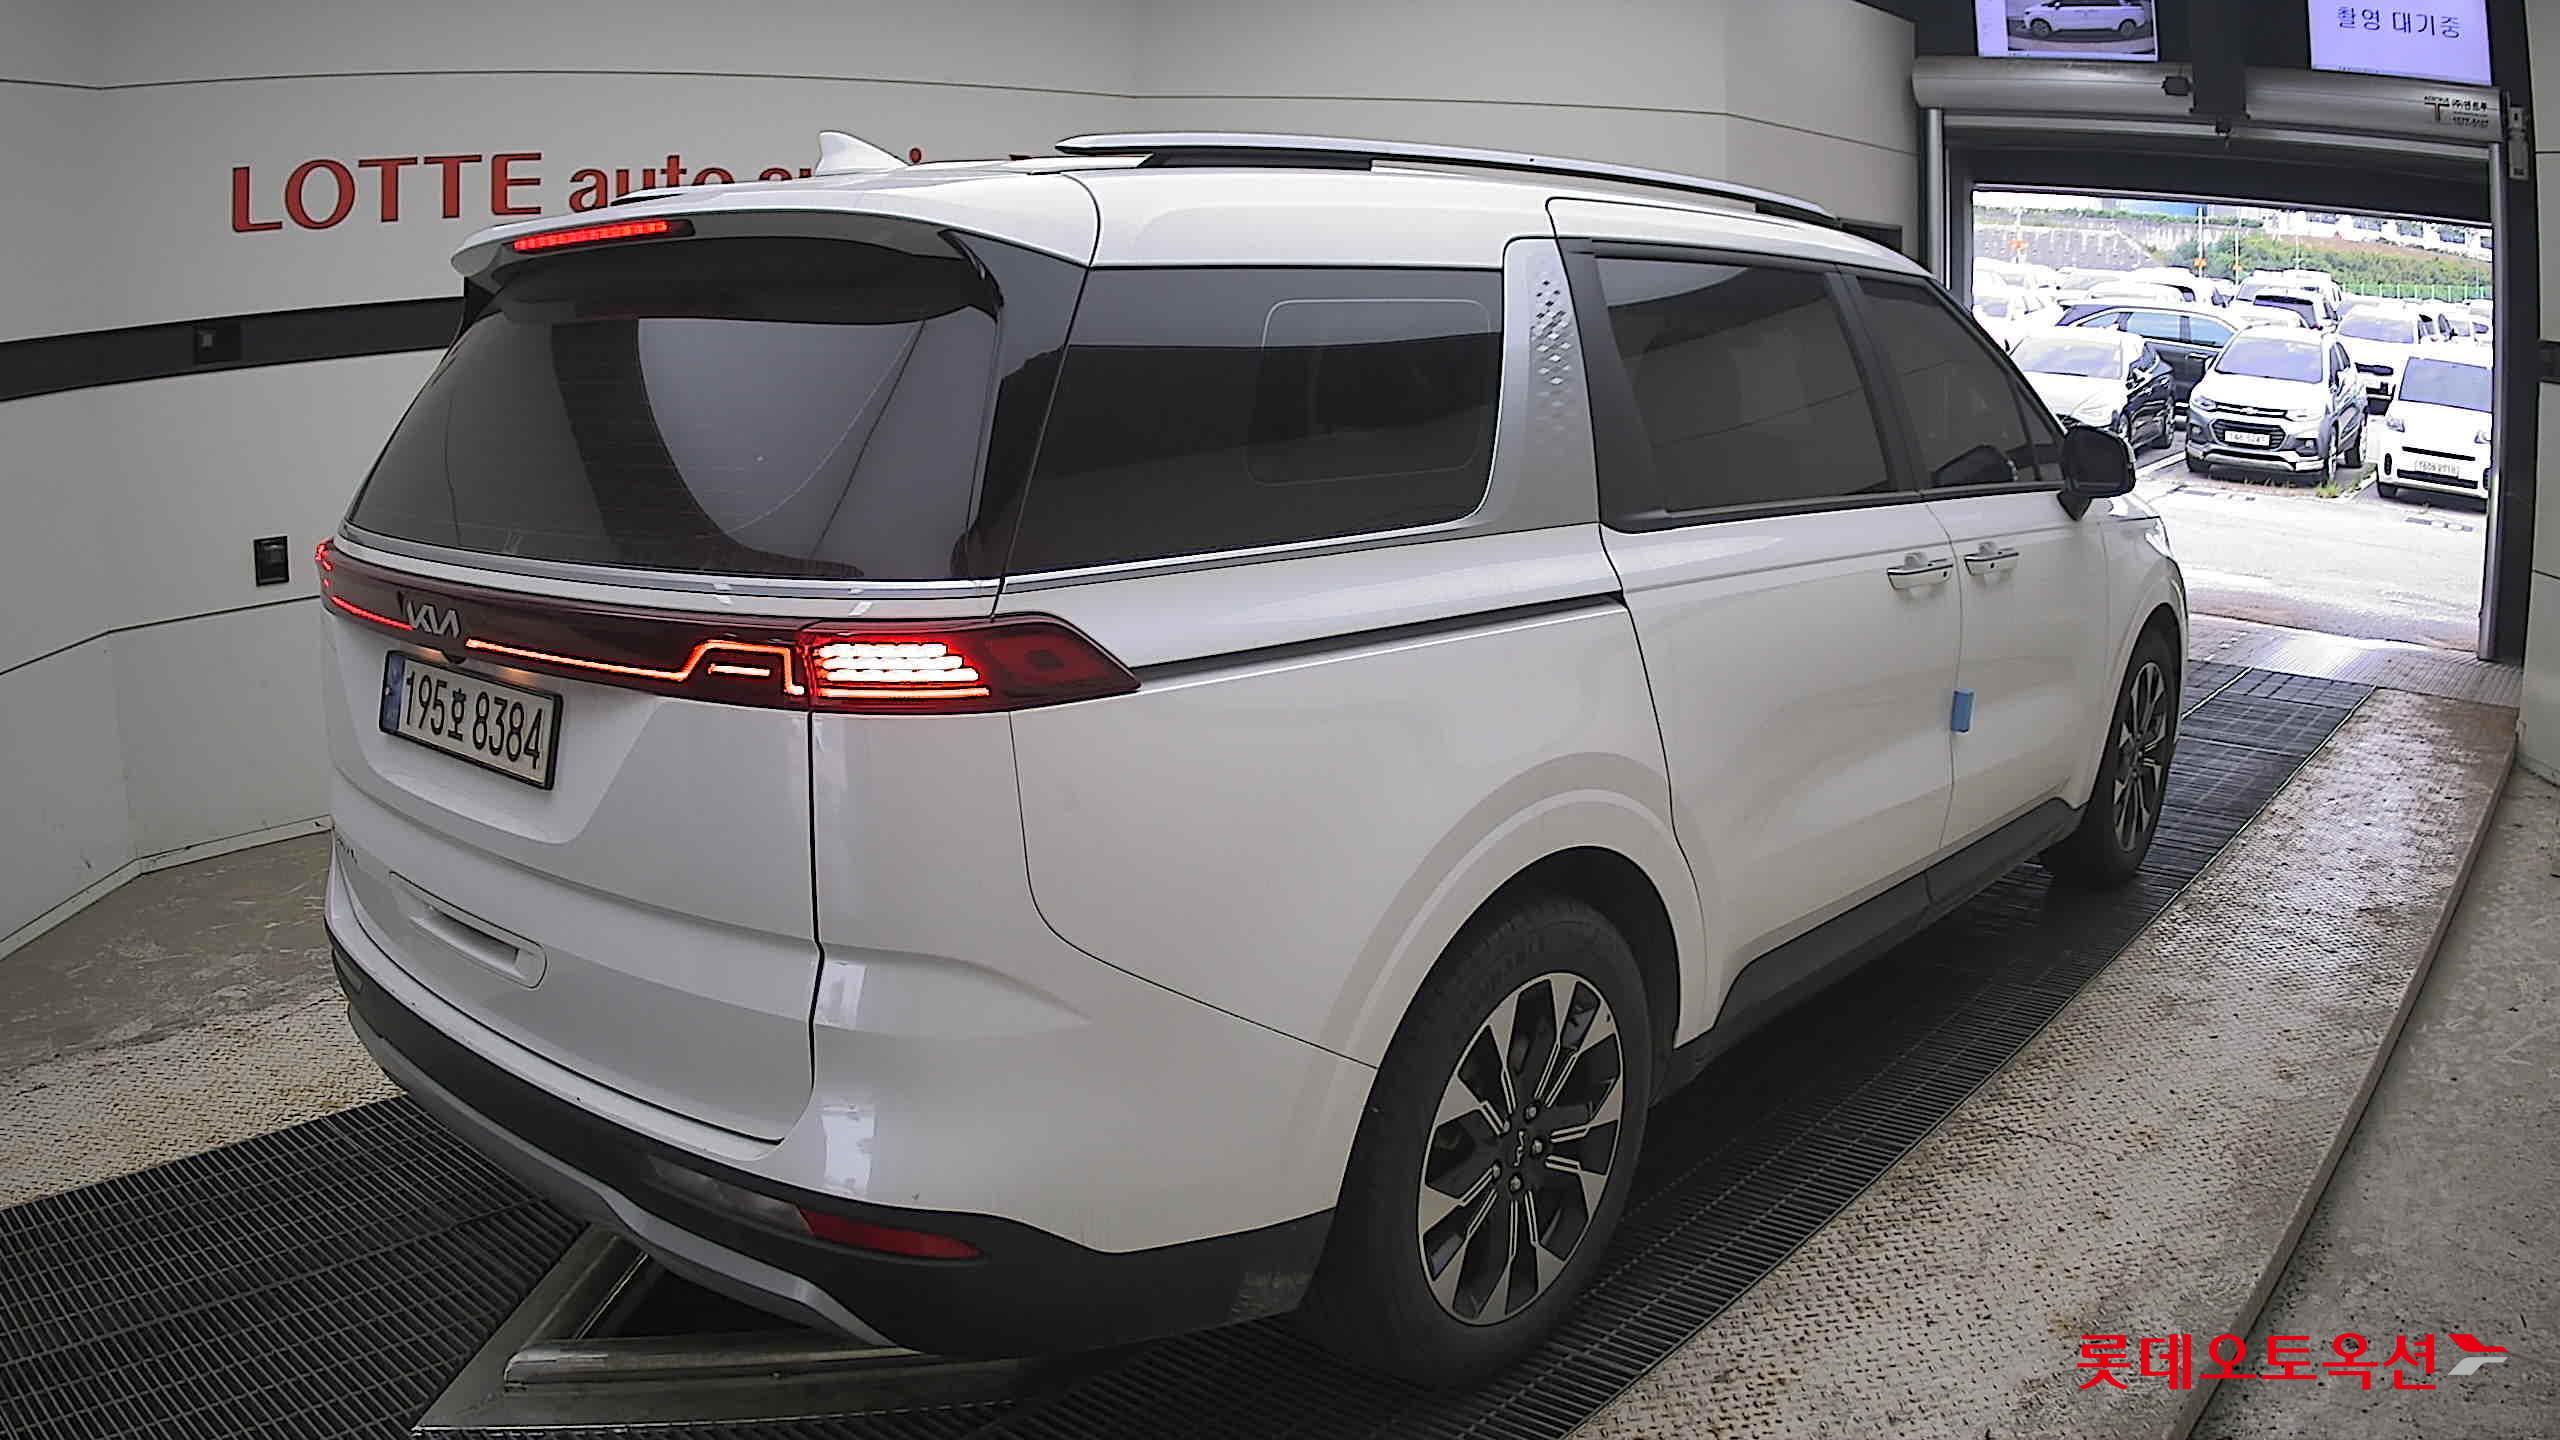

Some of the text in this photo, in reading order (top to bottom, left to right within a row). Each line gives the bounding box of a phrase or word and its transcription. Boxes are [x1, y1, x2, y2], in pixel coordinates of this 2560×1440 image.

[2337, 6, 2460, 39] 촬영 대기중
[232, 152, 542, 233] LOTTE
[406, 601, 461, 638] KIA
[406, 671, 543, 770] 195호 8384
